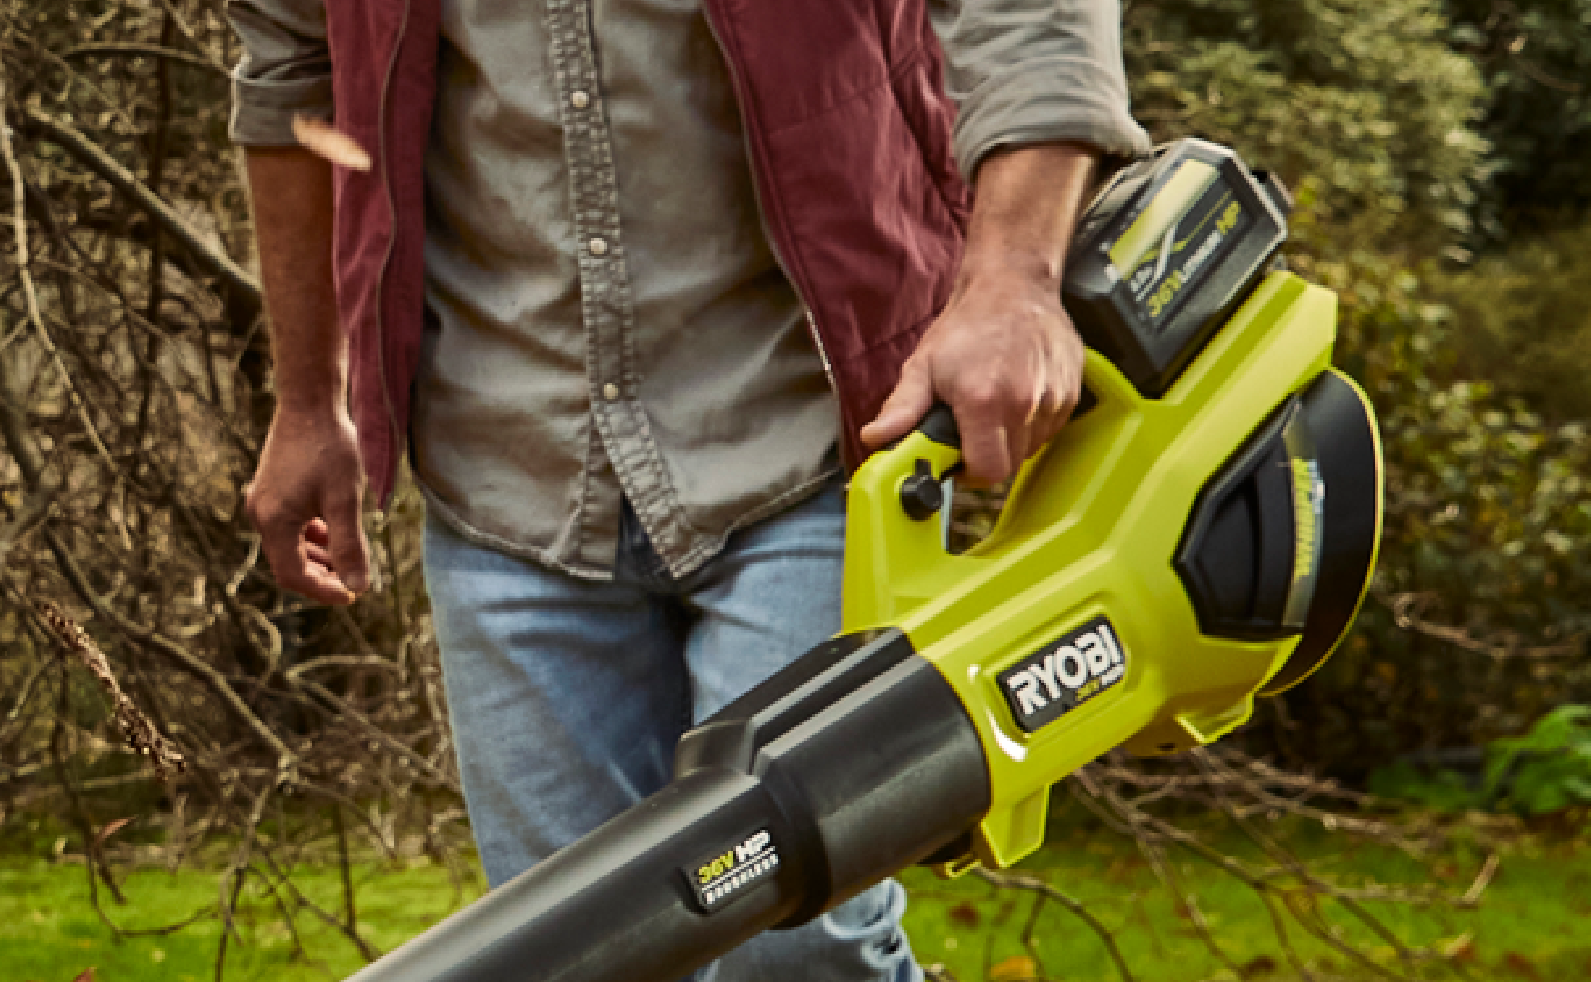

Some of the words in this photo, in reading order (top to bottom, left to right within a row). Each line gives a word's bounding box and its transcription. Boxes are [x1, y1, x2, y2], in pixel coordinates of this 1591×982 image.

[1008, 624, 1122, 715] RYOBI
[698, 850, 734, 884] 36V
[735, 831, 771, 863] HP
